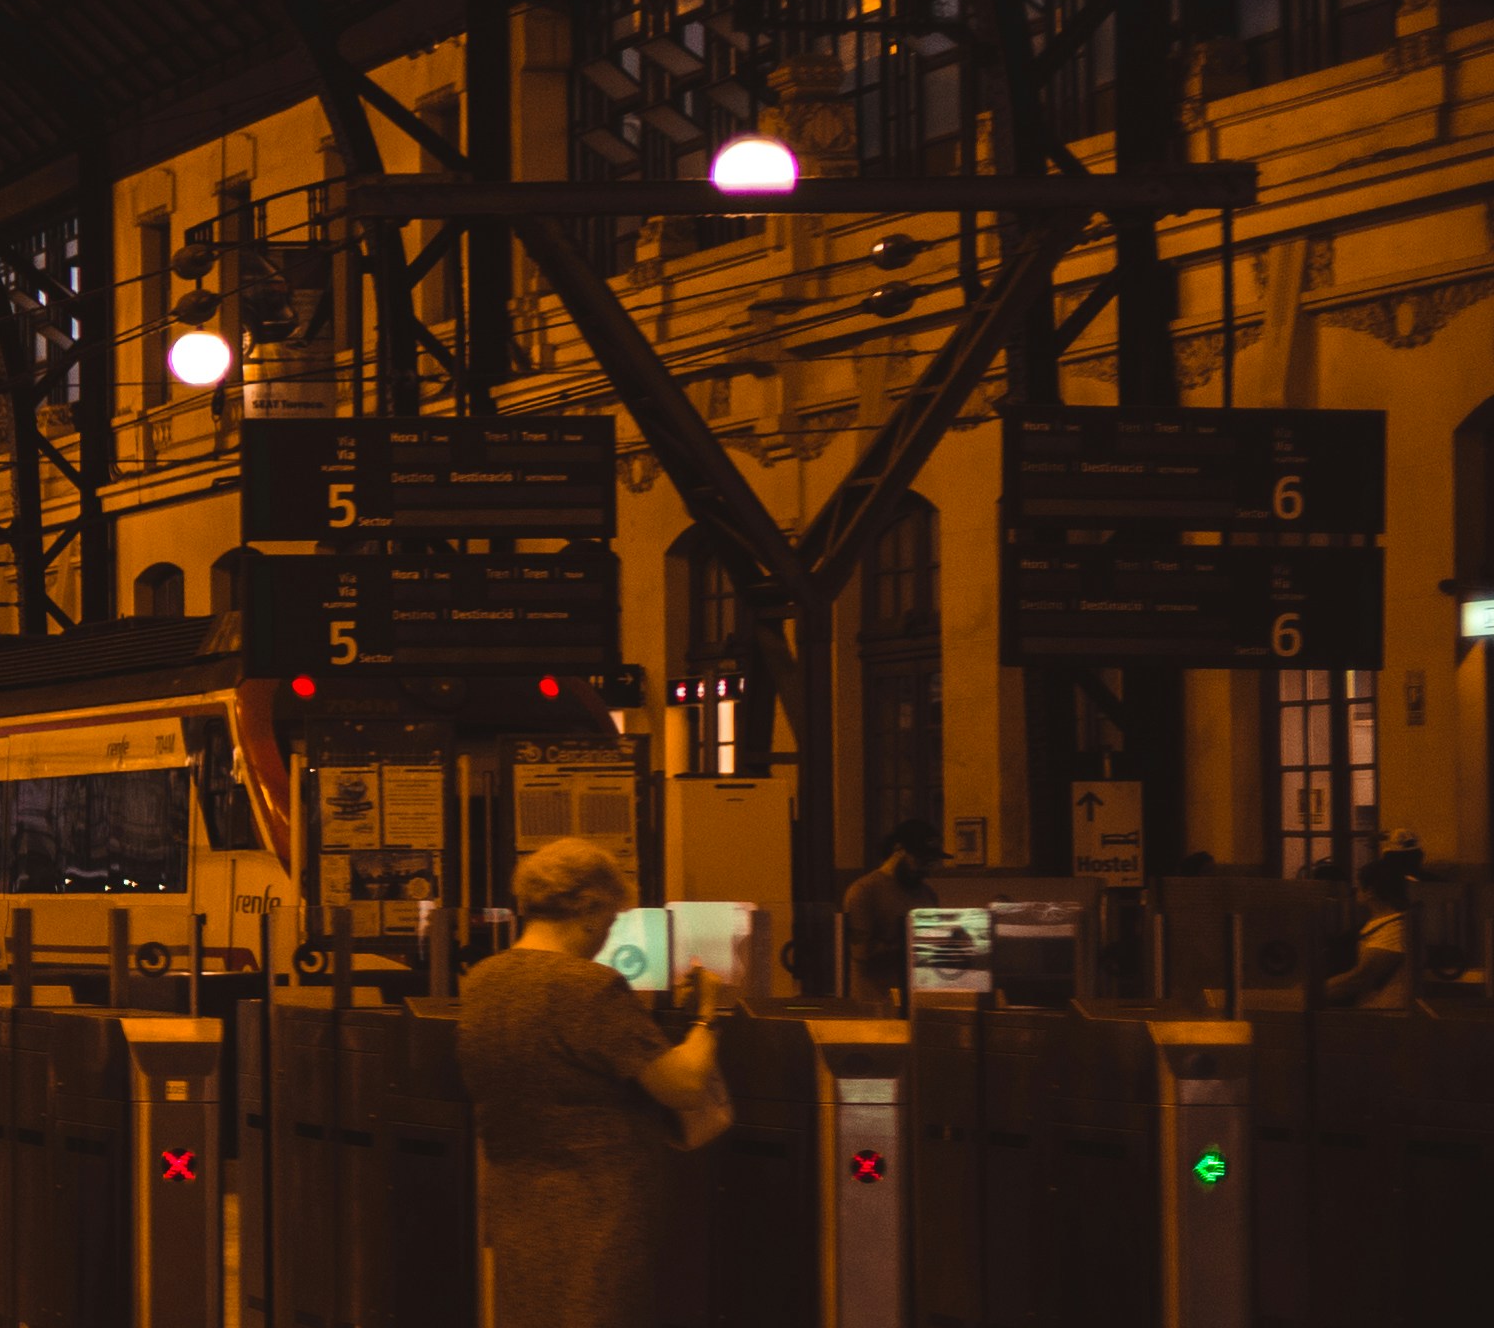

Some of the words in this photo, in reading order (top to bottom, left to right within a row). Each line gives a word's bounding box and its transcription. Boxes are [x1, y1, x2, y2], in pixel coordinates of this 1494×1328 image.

[328, 483, 357, 528] 5
[1272, 474, 1305, 521] 6
[329, 620, 358, 665] 5
[1271, 611, 1303, 657] 6
[1077, 854, 1139, 873] Hostel
[235, 884, 282, 915] renfe
